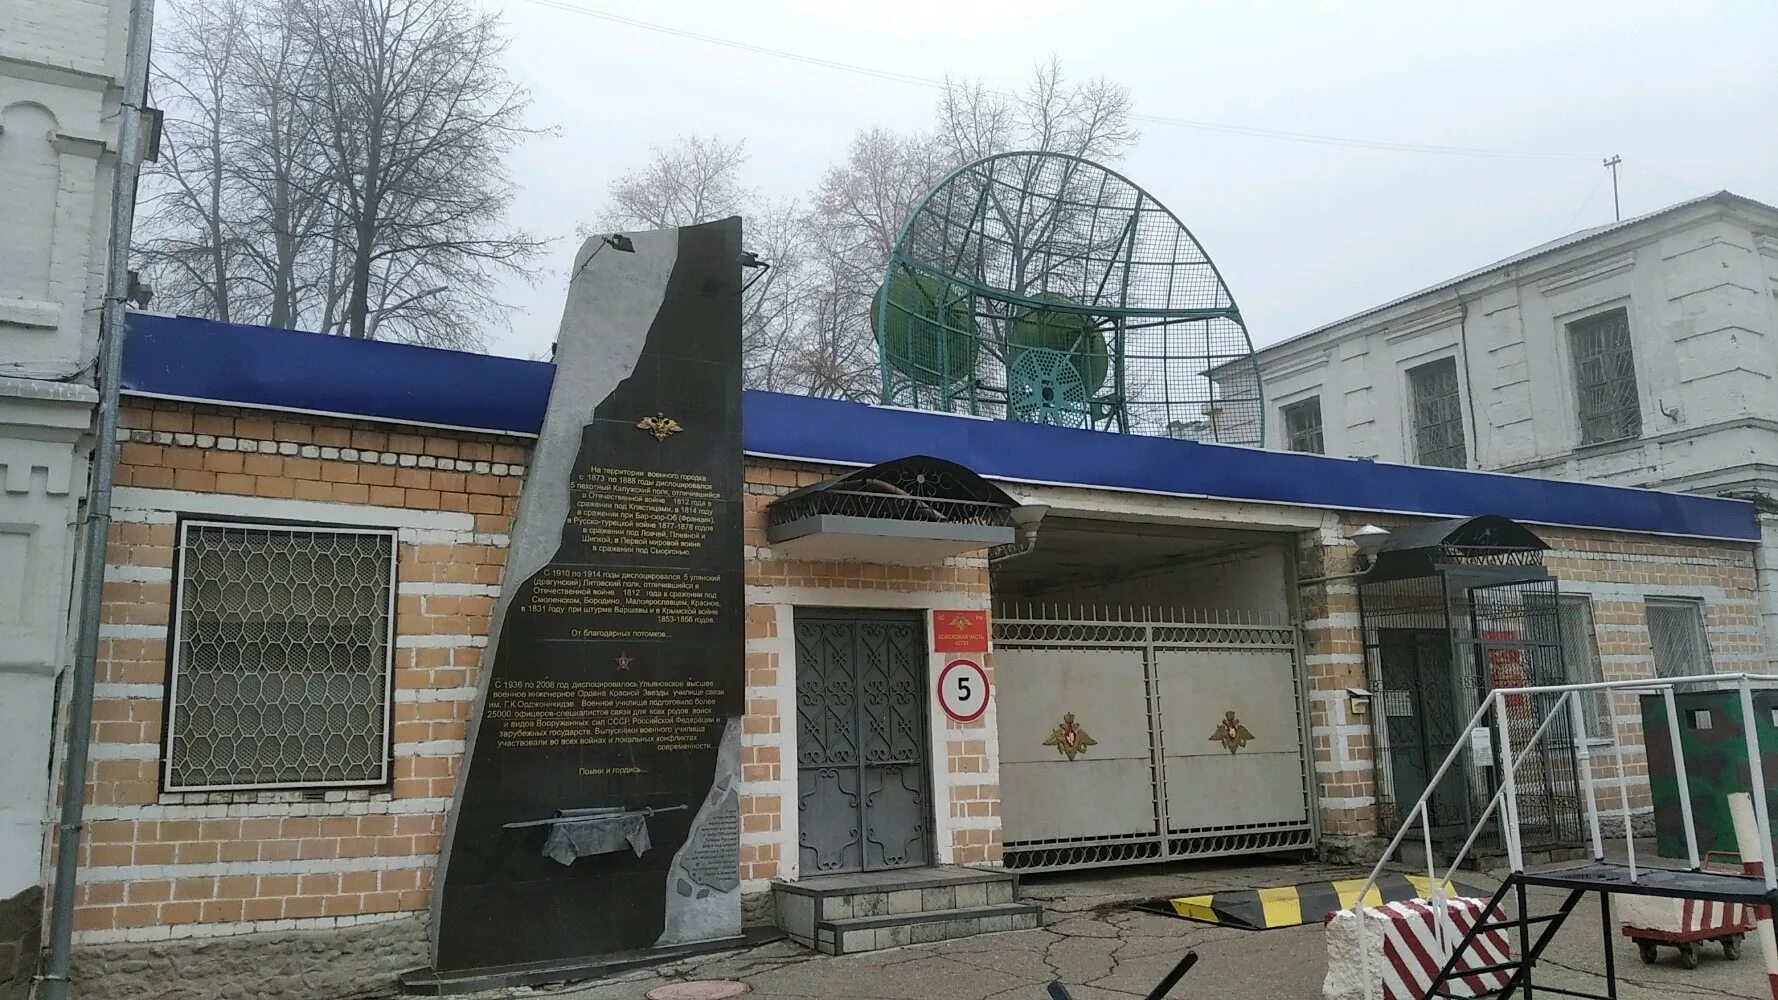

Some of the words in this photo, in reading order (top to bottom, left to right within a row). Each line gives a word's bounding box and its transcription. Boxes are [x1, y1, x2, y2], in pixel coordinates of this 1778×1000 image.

[603, 468, 644, 476] территории
[613, 485, 650, 493] Калужский
[652, 488, 670, 497] полк,
[589, 492, 642, 502] Отечественной
[582, 535, 612, 543] Шипкой,
[621, 537, 647, 545] Первой
[534, 578, 581, 587] (драгунский)
[533, 587, 591, 595] Отечественной
[532, 596, 581, 604] Смоленском,
[614, 606, 648, 614] Варшавы
[584, 630, 631, 638] благодарных
[958, 678, 971, 701] 5
[498, 730, 547, 738] зарубежных
[595, 727, 638, 736] Выпускники
[497, 739, 547, 748] участвовали
[579, 768, 603, 776] Помни
